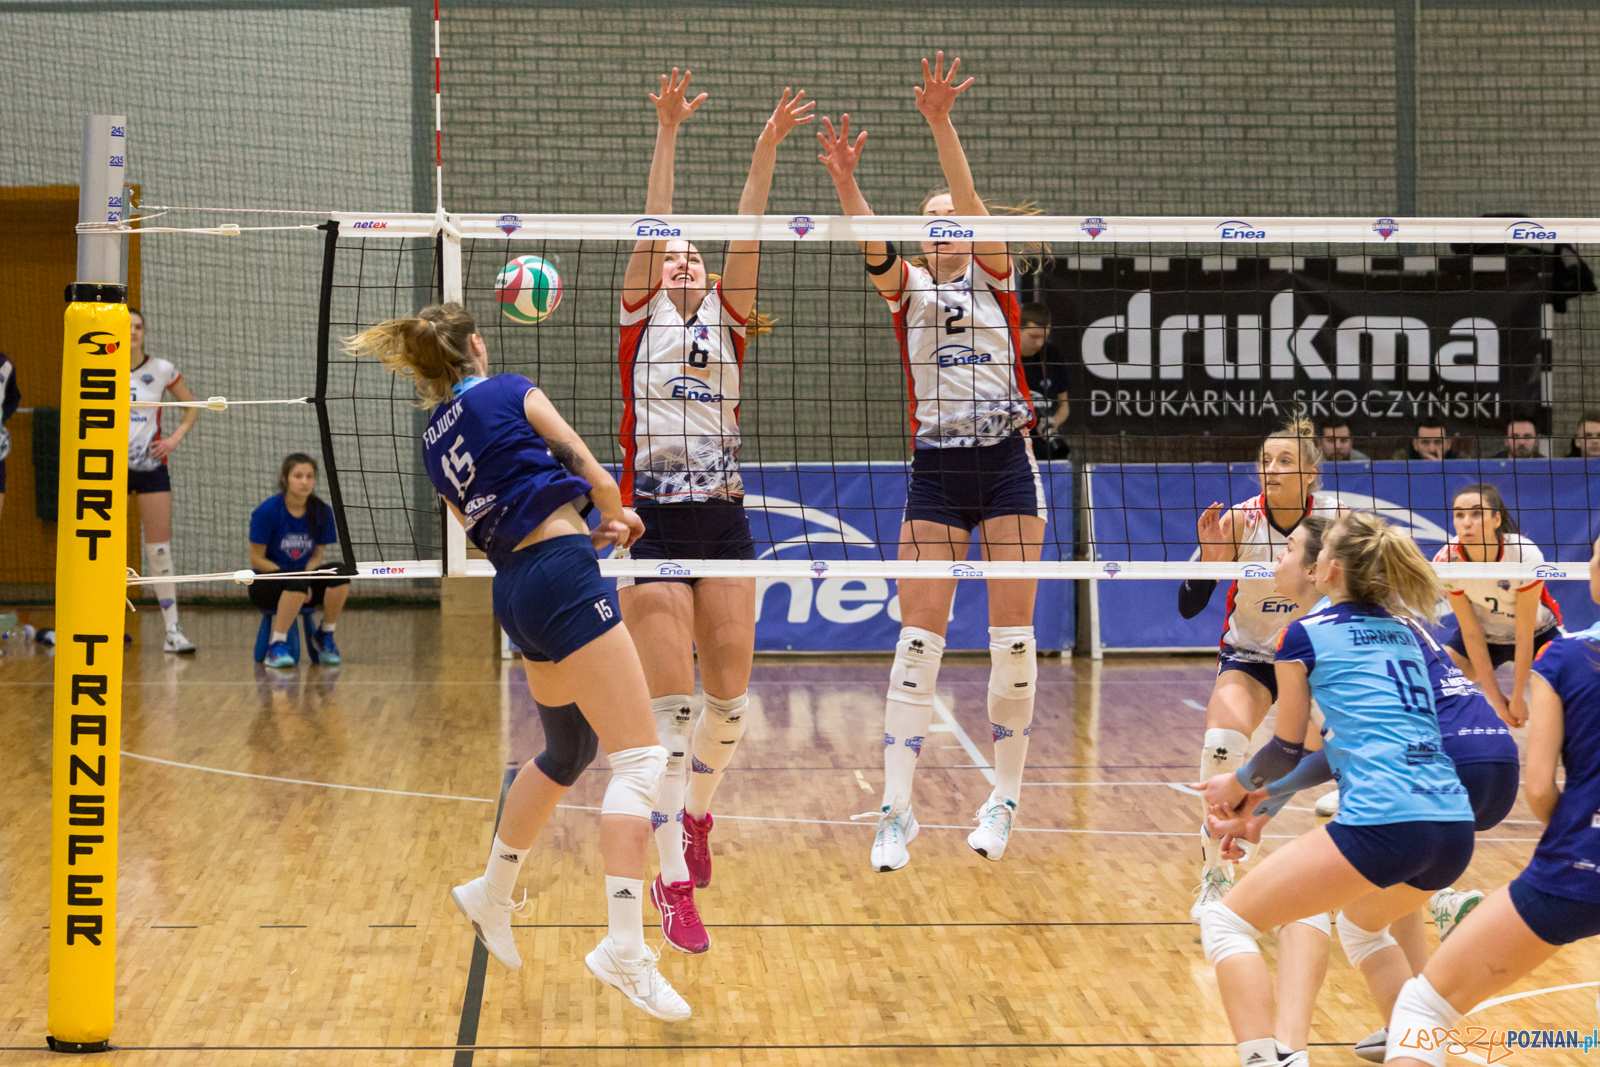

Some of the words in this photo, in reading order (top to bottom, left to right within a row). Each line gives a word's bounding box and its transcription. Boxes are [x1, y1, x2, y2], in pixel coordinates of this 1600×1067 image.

[111, 126, 125, 136] 243
[109, 156, 124, 166] 235
[353, 221, 387, 229] netex
[636, 226, 681, 236] Enea
[929, 227, 974, 238] Enea
[1221, 228, 1266, 239] Enea
[1512, 229, 1557, 240] Enea
[944, 306, 966, 335] 2
[1081, 289, 1499, 382] drukma
[938, 353, 991, 368] Enea
[671, 385, 724, 403] Enea
[1091, 390, 1279, 417] DRUKARNIA
[1293, 385, 1500, 418] SKOCZYŃSKI
[76, 368, 116, 561] SPORT
[441, 434, 476, 500] 15
[660, 567, 691, 576] Enea
[952, 569, 983, 577] Enea
[1244, 569, 1275, 578] Enea
[1536, 570, 1567, 578] Enea
[594, 599, 613, 621] 15
[1385, 660, 1434, 716] 16
[67, 634, 108, 946] TRANSFER
